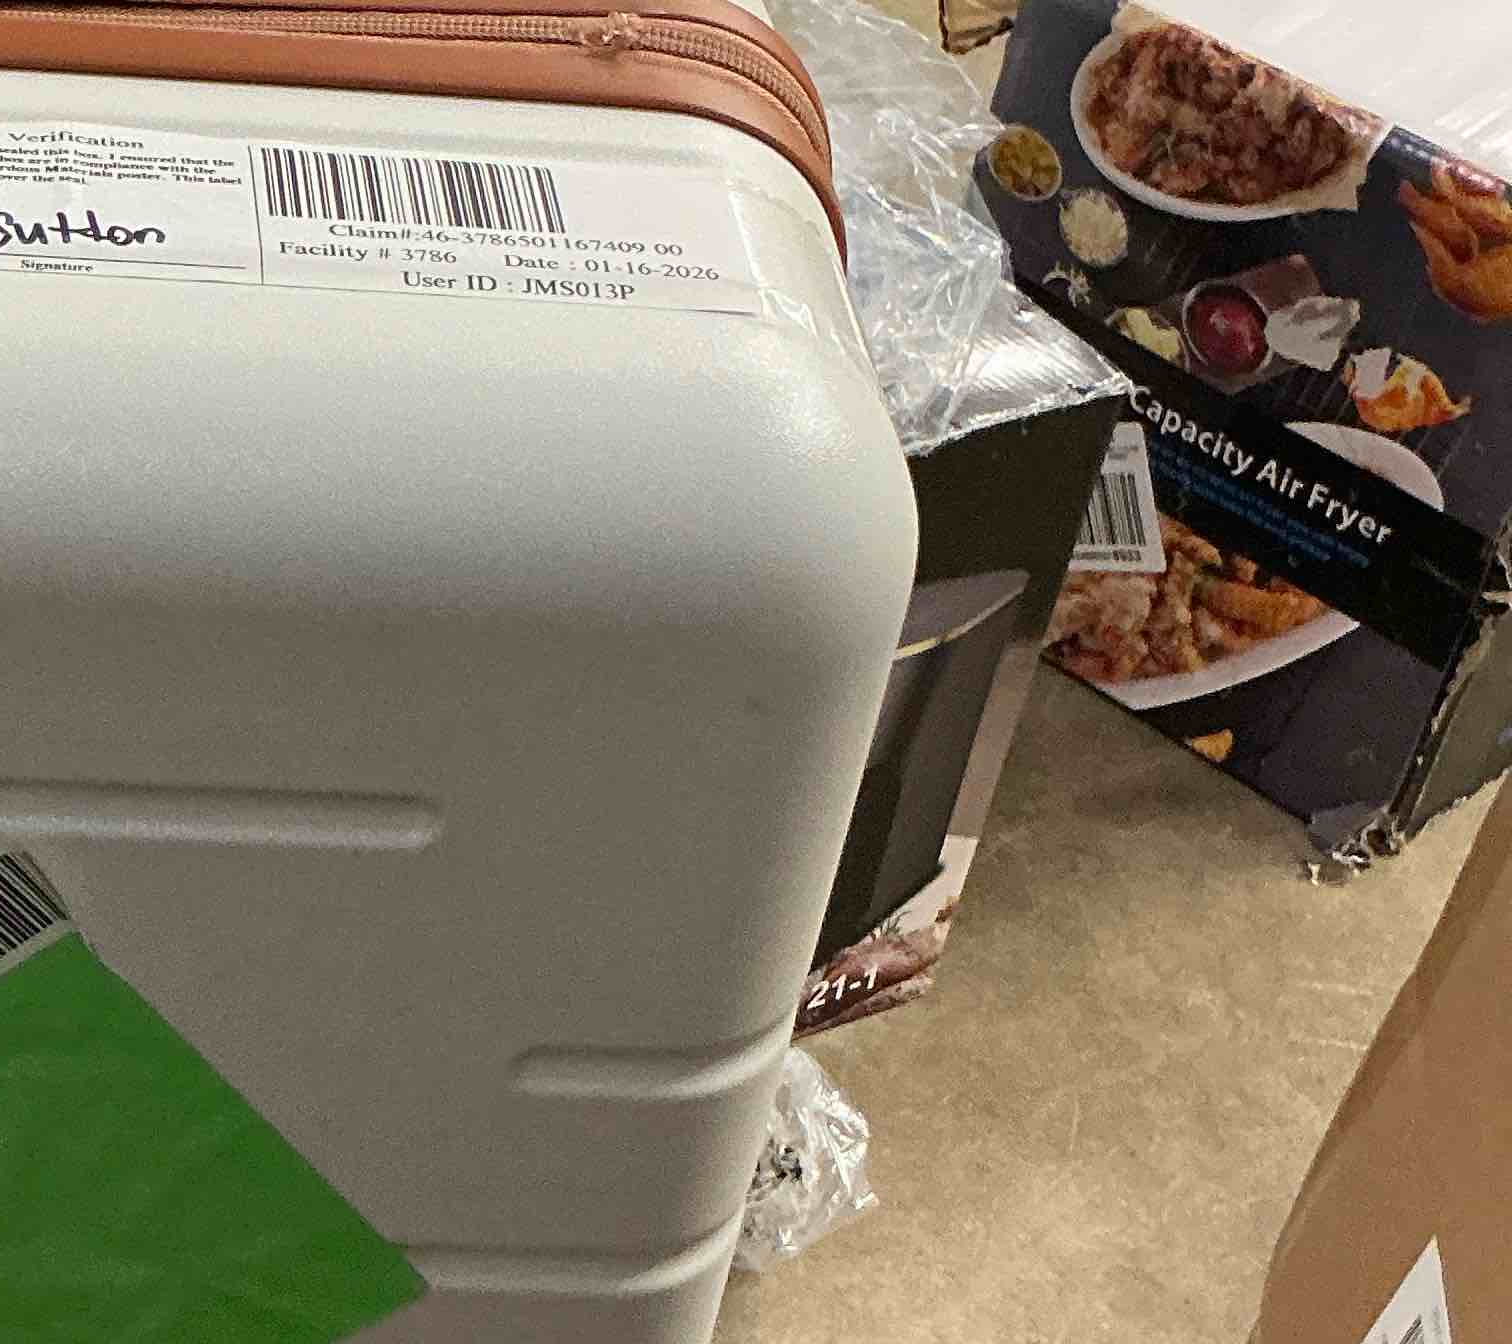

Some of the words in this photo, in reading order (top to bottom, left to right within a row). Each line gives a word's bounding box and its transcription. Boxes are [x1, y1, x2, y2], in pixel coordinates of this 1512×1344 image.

[8, 131, 144, 149] Verification
[0, 155, 24, 164] box
[73, 159, 154, 170] compliance
[158, 165, 189, 173] with
[43, 148, 70, 156] this
[120, 154, 177, 163] ensured
[181, 157, 209, 166] that
[212, 159, 235, 167] the
[33, 174, 56, 183] the
[45, 165, 113, 178] Materials
[172, 173, 204, 183] This
[209, 176, 242, 185] label
[654, 242, 683, 258] 00
[19, 258, 94, 272] Signature
[279, 241, 368, 262] Facility
[377, 248, 391, 260] #
[400, 247, 457, 265] 3786
[504, 254, 560, 271] Date
[585, 258, 720, 282] 01-16-2026
[402, 270, 457, 291] User
[468, 274, 497, 292] ID
[521, 277, 635, 300] JMS013P
[1129, 385, 1254, 476] Capacity
[1256, 459, 1304, 500] Air
[1307, 482, 1392, 544] Fryer
